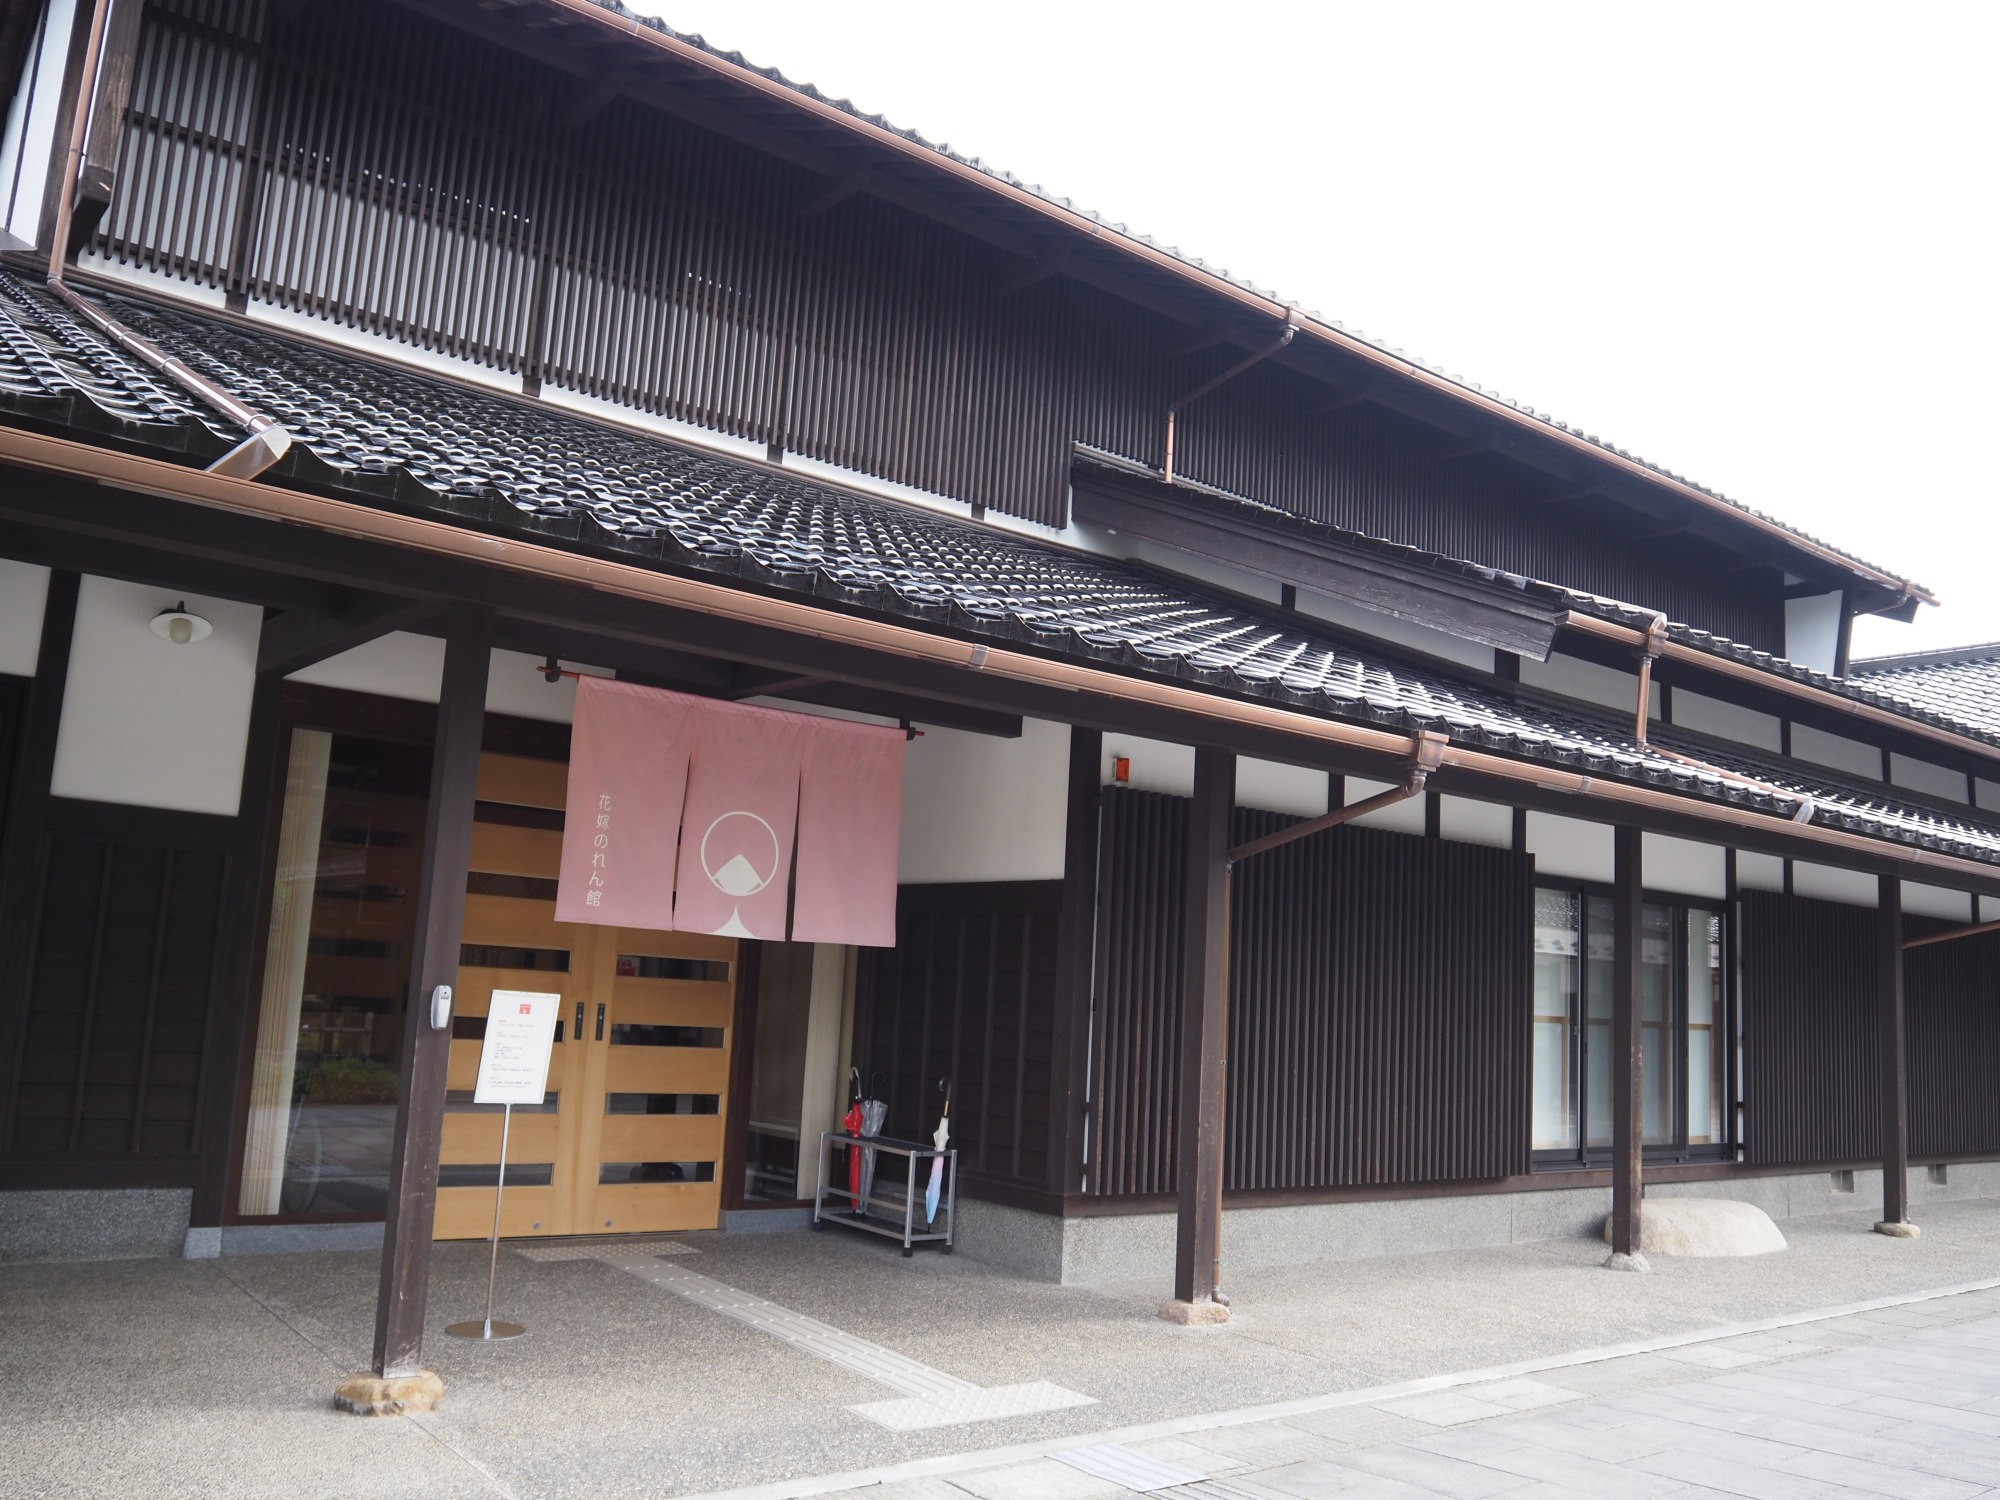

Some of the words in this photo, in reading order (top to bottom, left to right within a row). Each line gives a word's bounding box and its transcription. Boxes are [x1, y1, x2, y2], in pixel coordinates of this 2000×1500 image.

[586, 794, 612, 907] 花嫁のれん館
